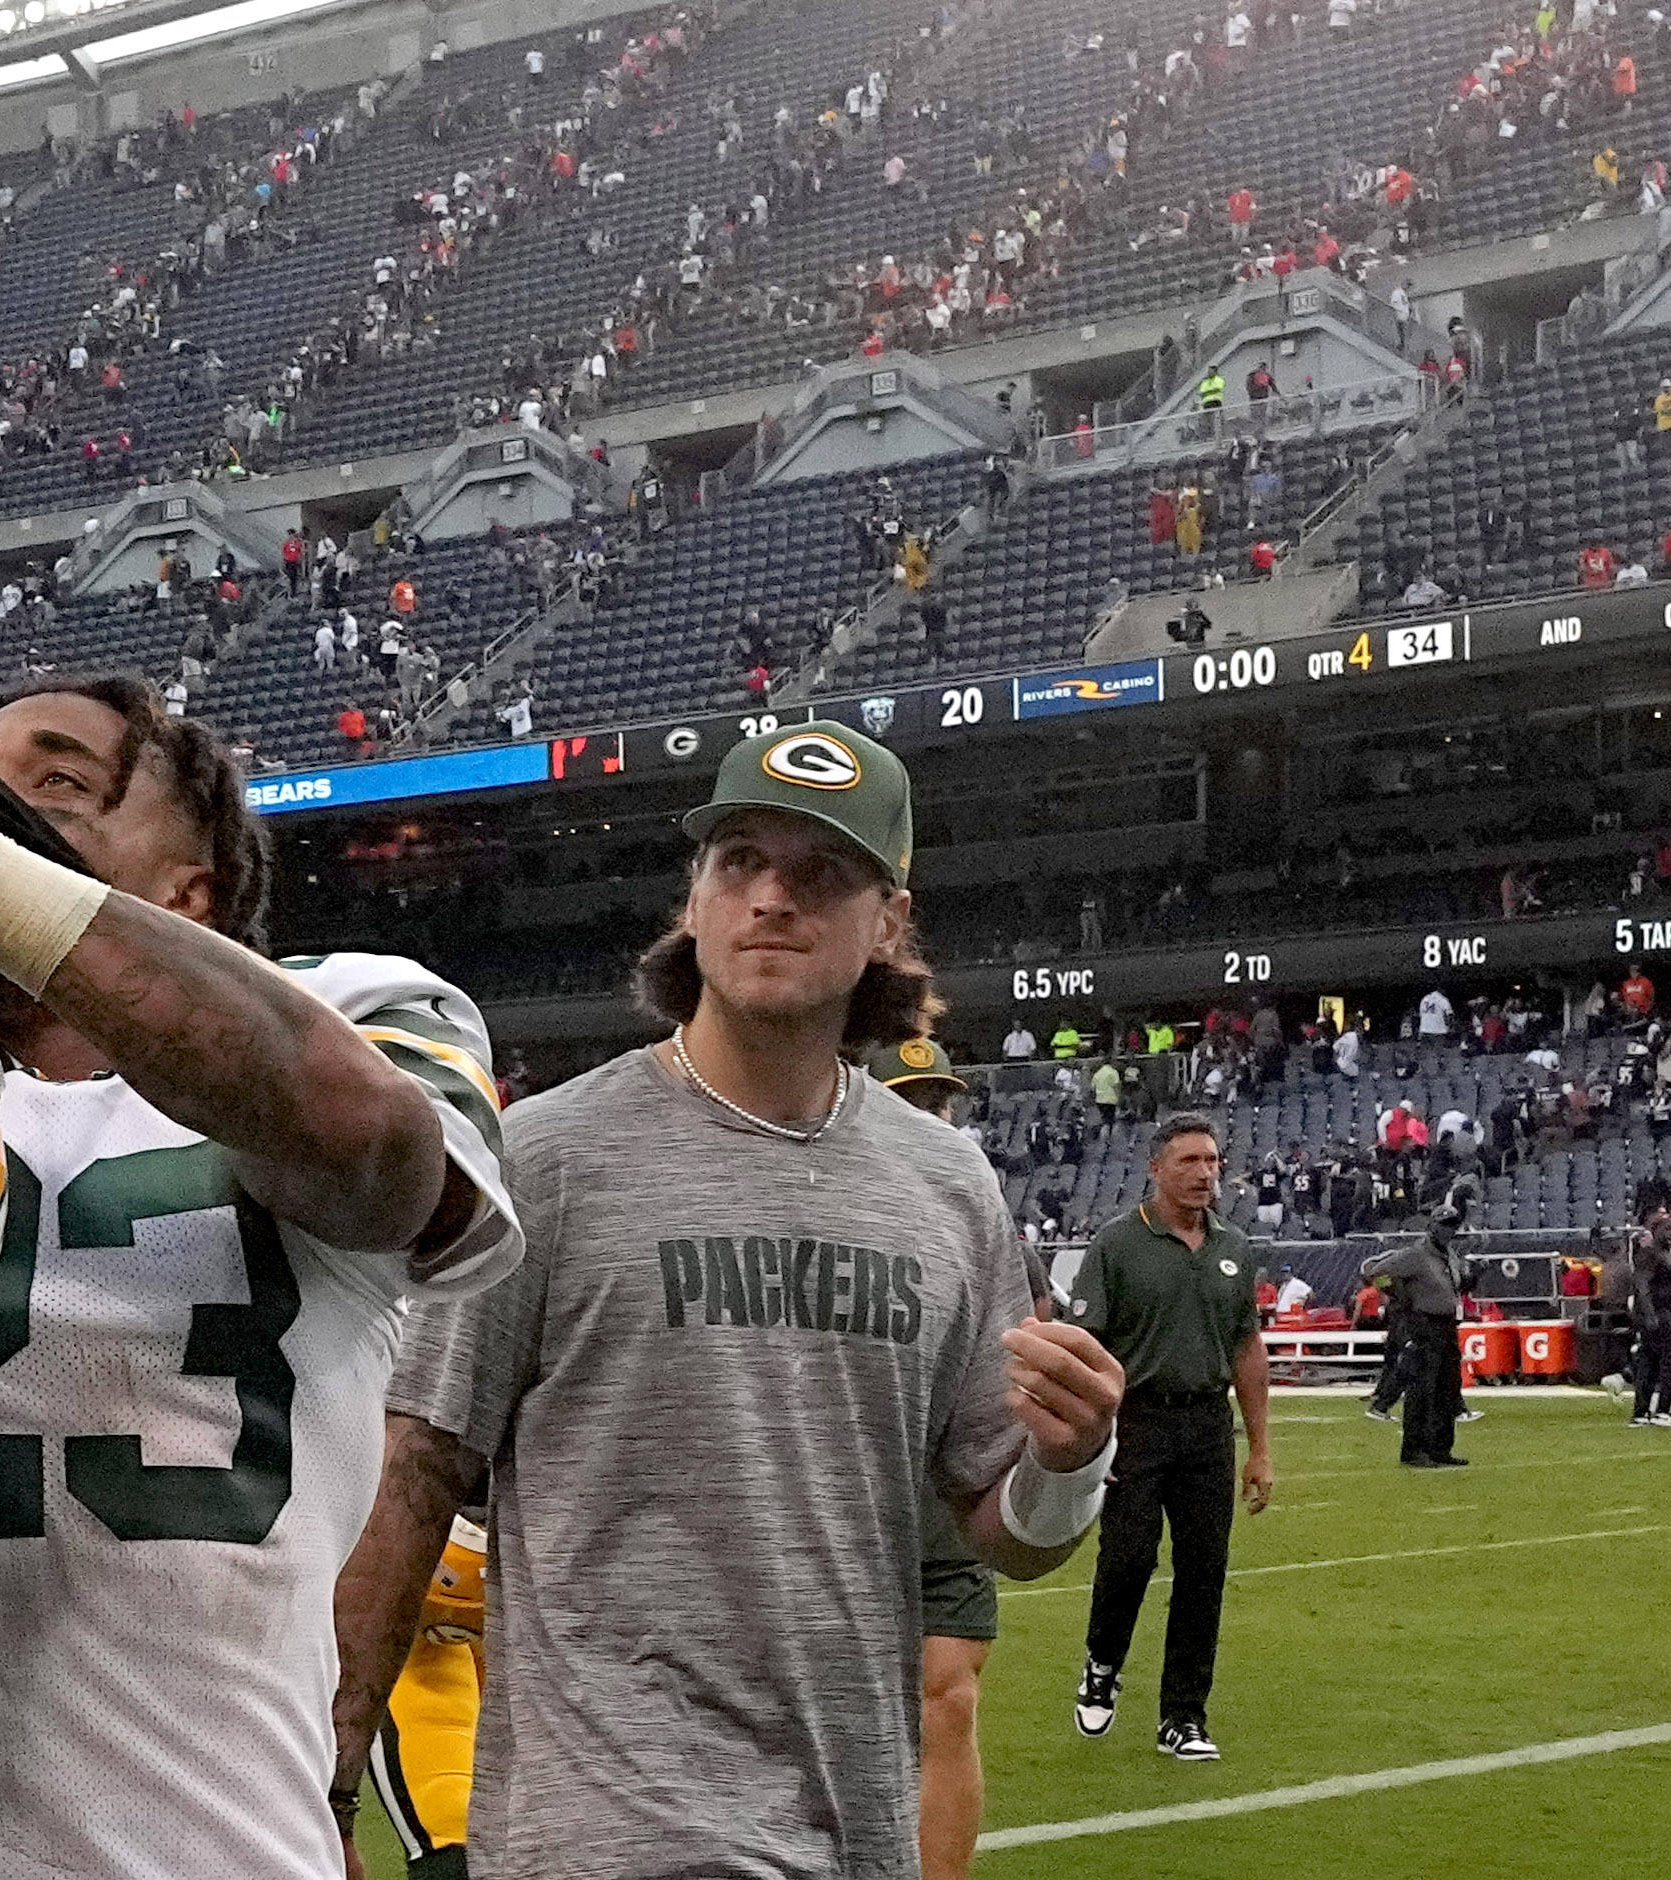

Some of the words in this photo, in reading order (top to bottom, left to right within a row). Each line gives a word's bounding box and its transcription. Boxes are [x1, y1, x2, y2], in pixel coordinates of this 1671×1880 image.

[1402, 628, 1439, 661] 34
[1540, 617, 1582, 646] AND
[1193, 647, 1276, 693] 0:00
[1308, 650, 1344, 681] QTR
[1347, 632, 1373, 671] 4
[1023, 687, 1071, 703] RIVERS
[1102, 676, 1154, 692] CASINO
[941, 687, 983, 726] 20
[1423, 935, 1442, 968] 8
[1447, 937, 1487, 966] YAC
[1615, 919, 1634, 952] 5
[1224, 951, 1241, 983] 2
[1246, 954, 1271, 982] TD
[1013, 968, 1052, 1000] 6.5
[1056, 969, 1095, 996] YPC
[664, 1237, 922, 1344] PACKERS
[1465, 1333, 1487, 1361] G
[1525, 1331, 1549, 1361] G
